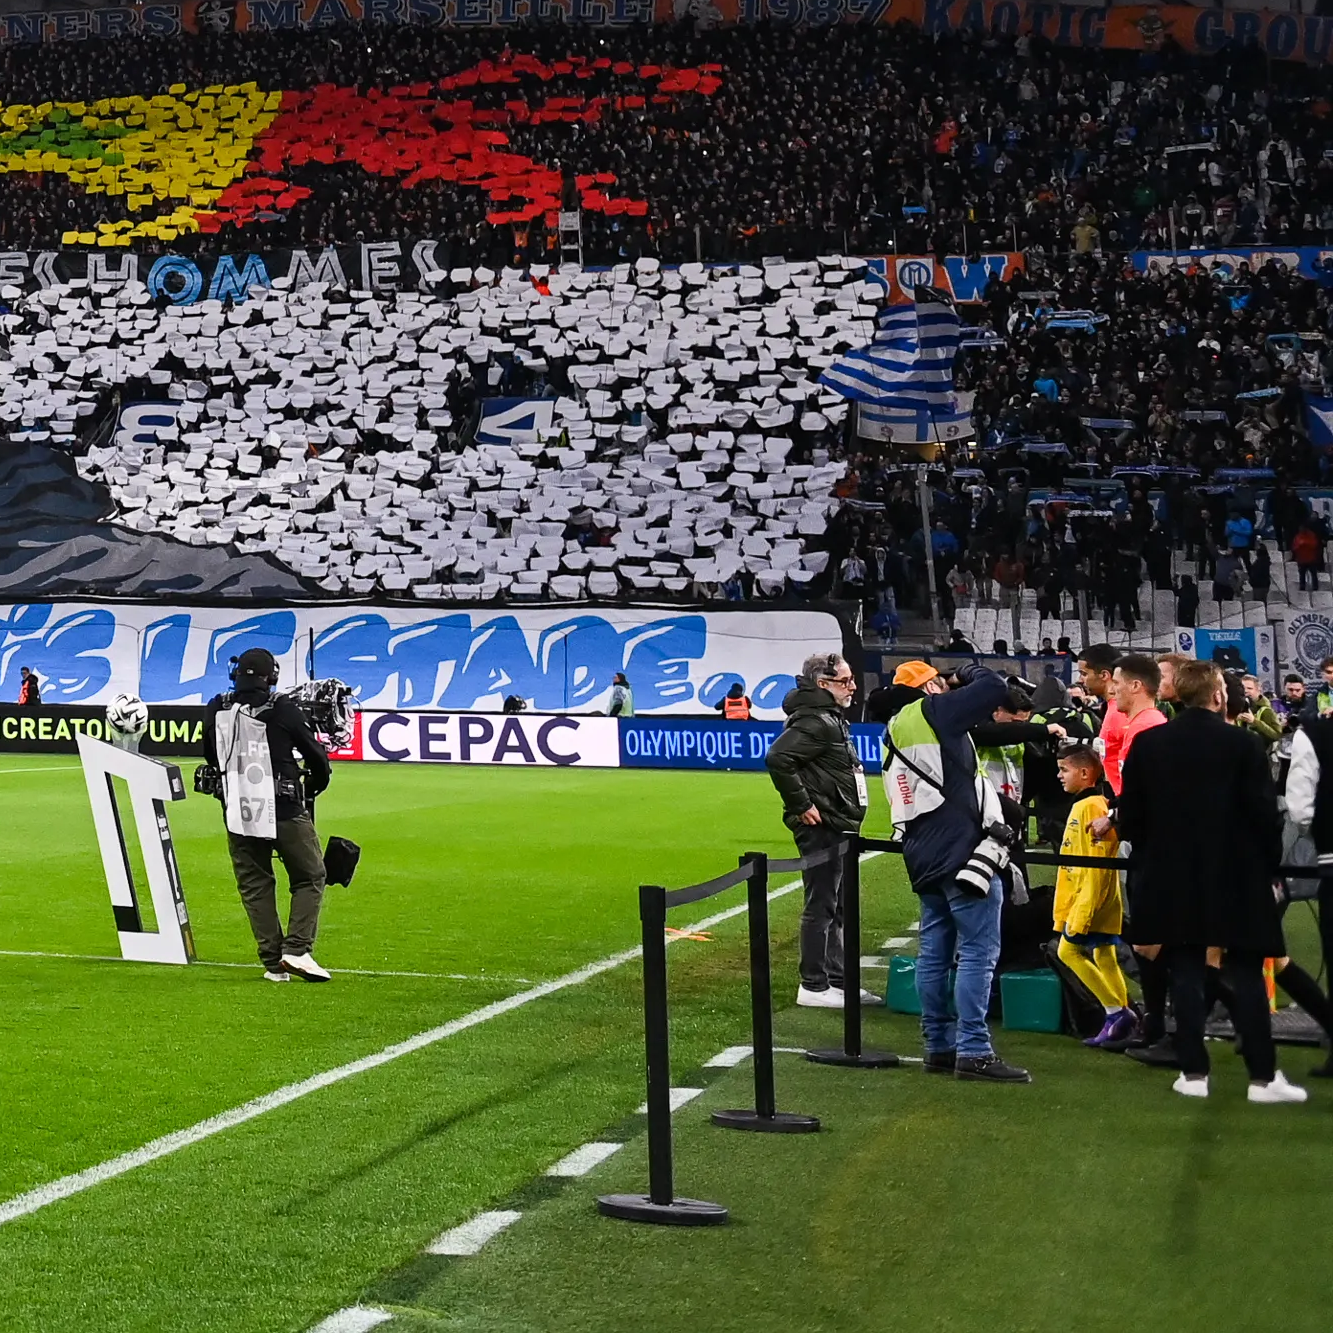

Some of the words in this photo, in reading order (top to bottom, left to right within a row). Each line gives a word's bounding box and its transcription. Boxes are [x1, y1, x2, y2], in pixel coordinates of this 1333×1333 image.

[138, 609, 296, 704] LE
[368, 713, 581, 764] CEPAC
[626, 729, 744, 764] OLYMPIQUE
[749, 732, 775, 757] DE
[896, 773, 914, 806] PHOTO
[239, 796, 266, 824] 67
